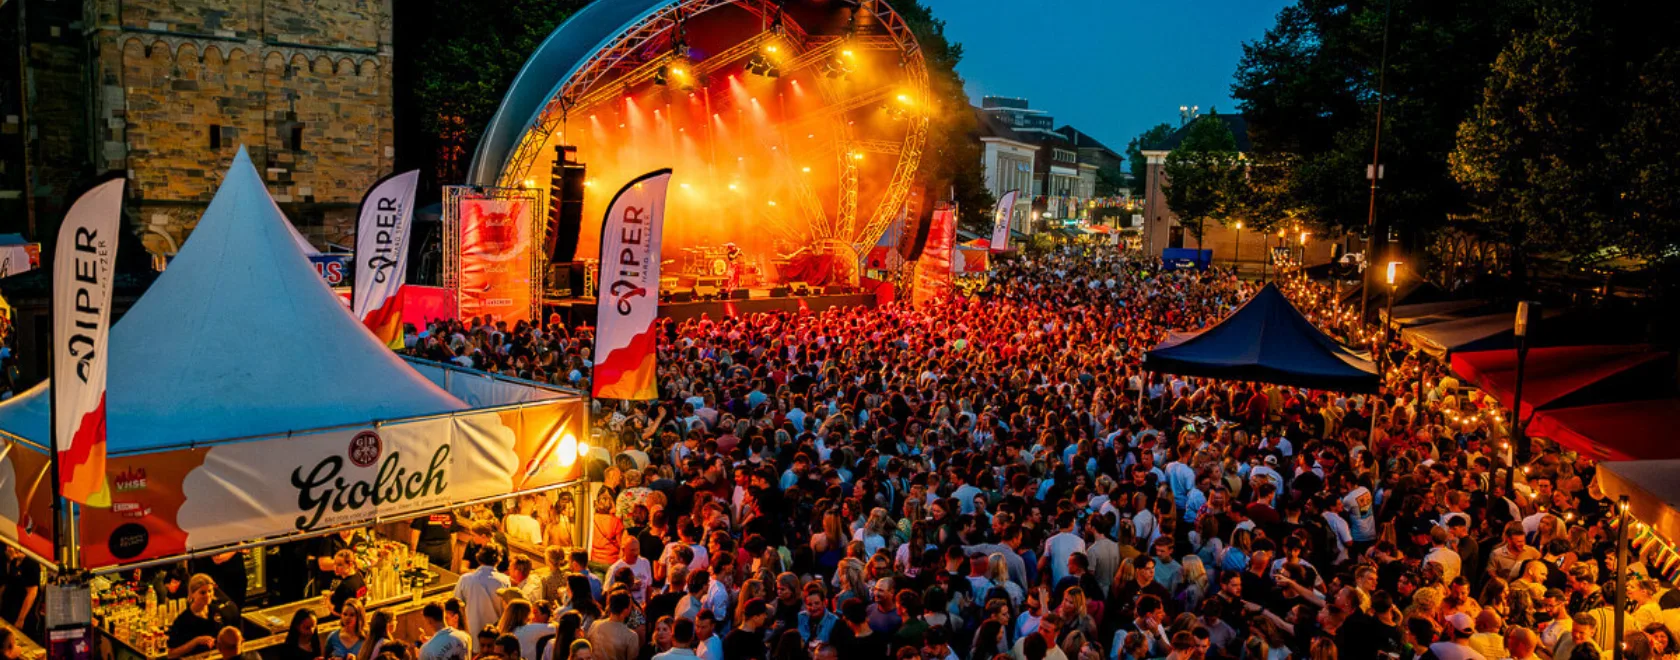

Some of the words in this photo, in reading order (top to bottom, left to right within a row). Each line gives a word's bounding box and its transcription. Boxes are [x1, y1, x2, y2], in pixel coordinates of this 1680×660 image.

[368, 197, 397, 284] VIPER
[610, 205, 646, 316] VIPER
[68, 225, 100, 385] VIPER
[116, 479, 147, 490] VHSE
[291, 444, 450, 530] Grolsch
